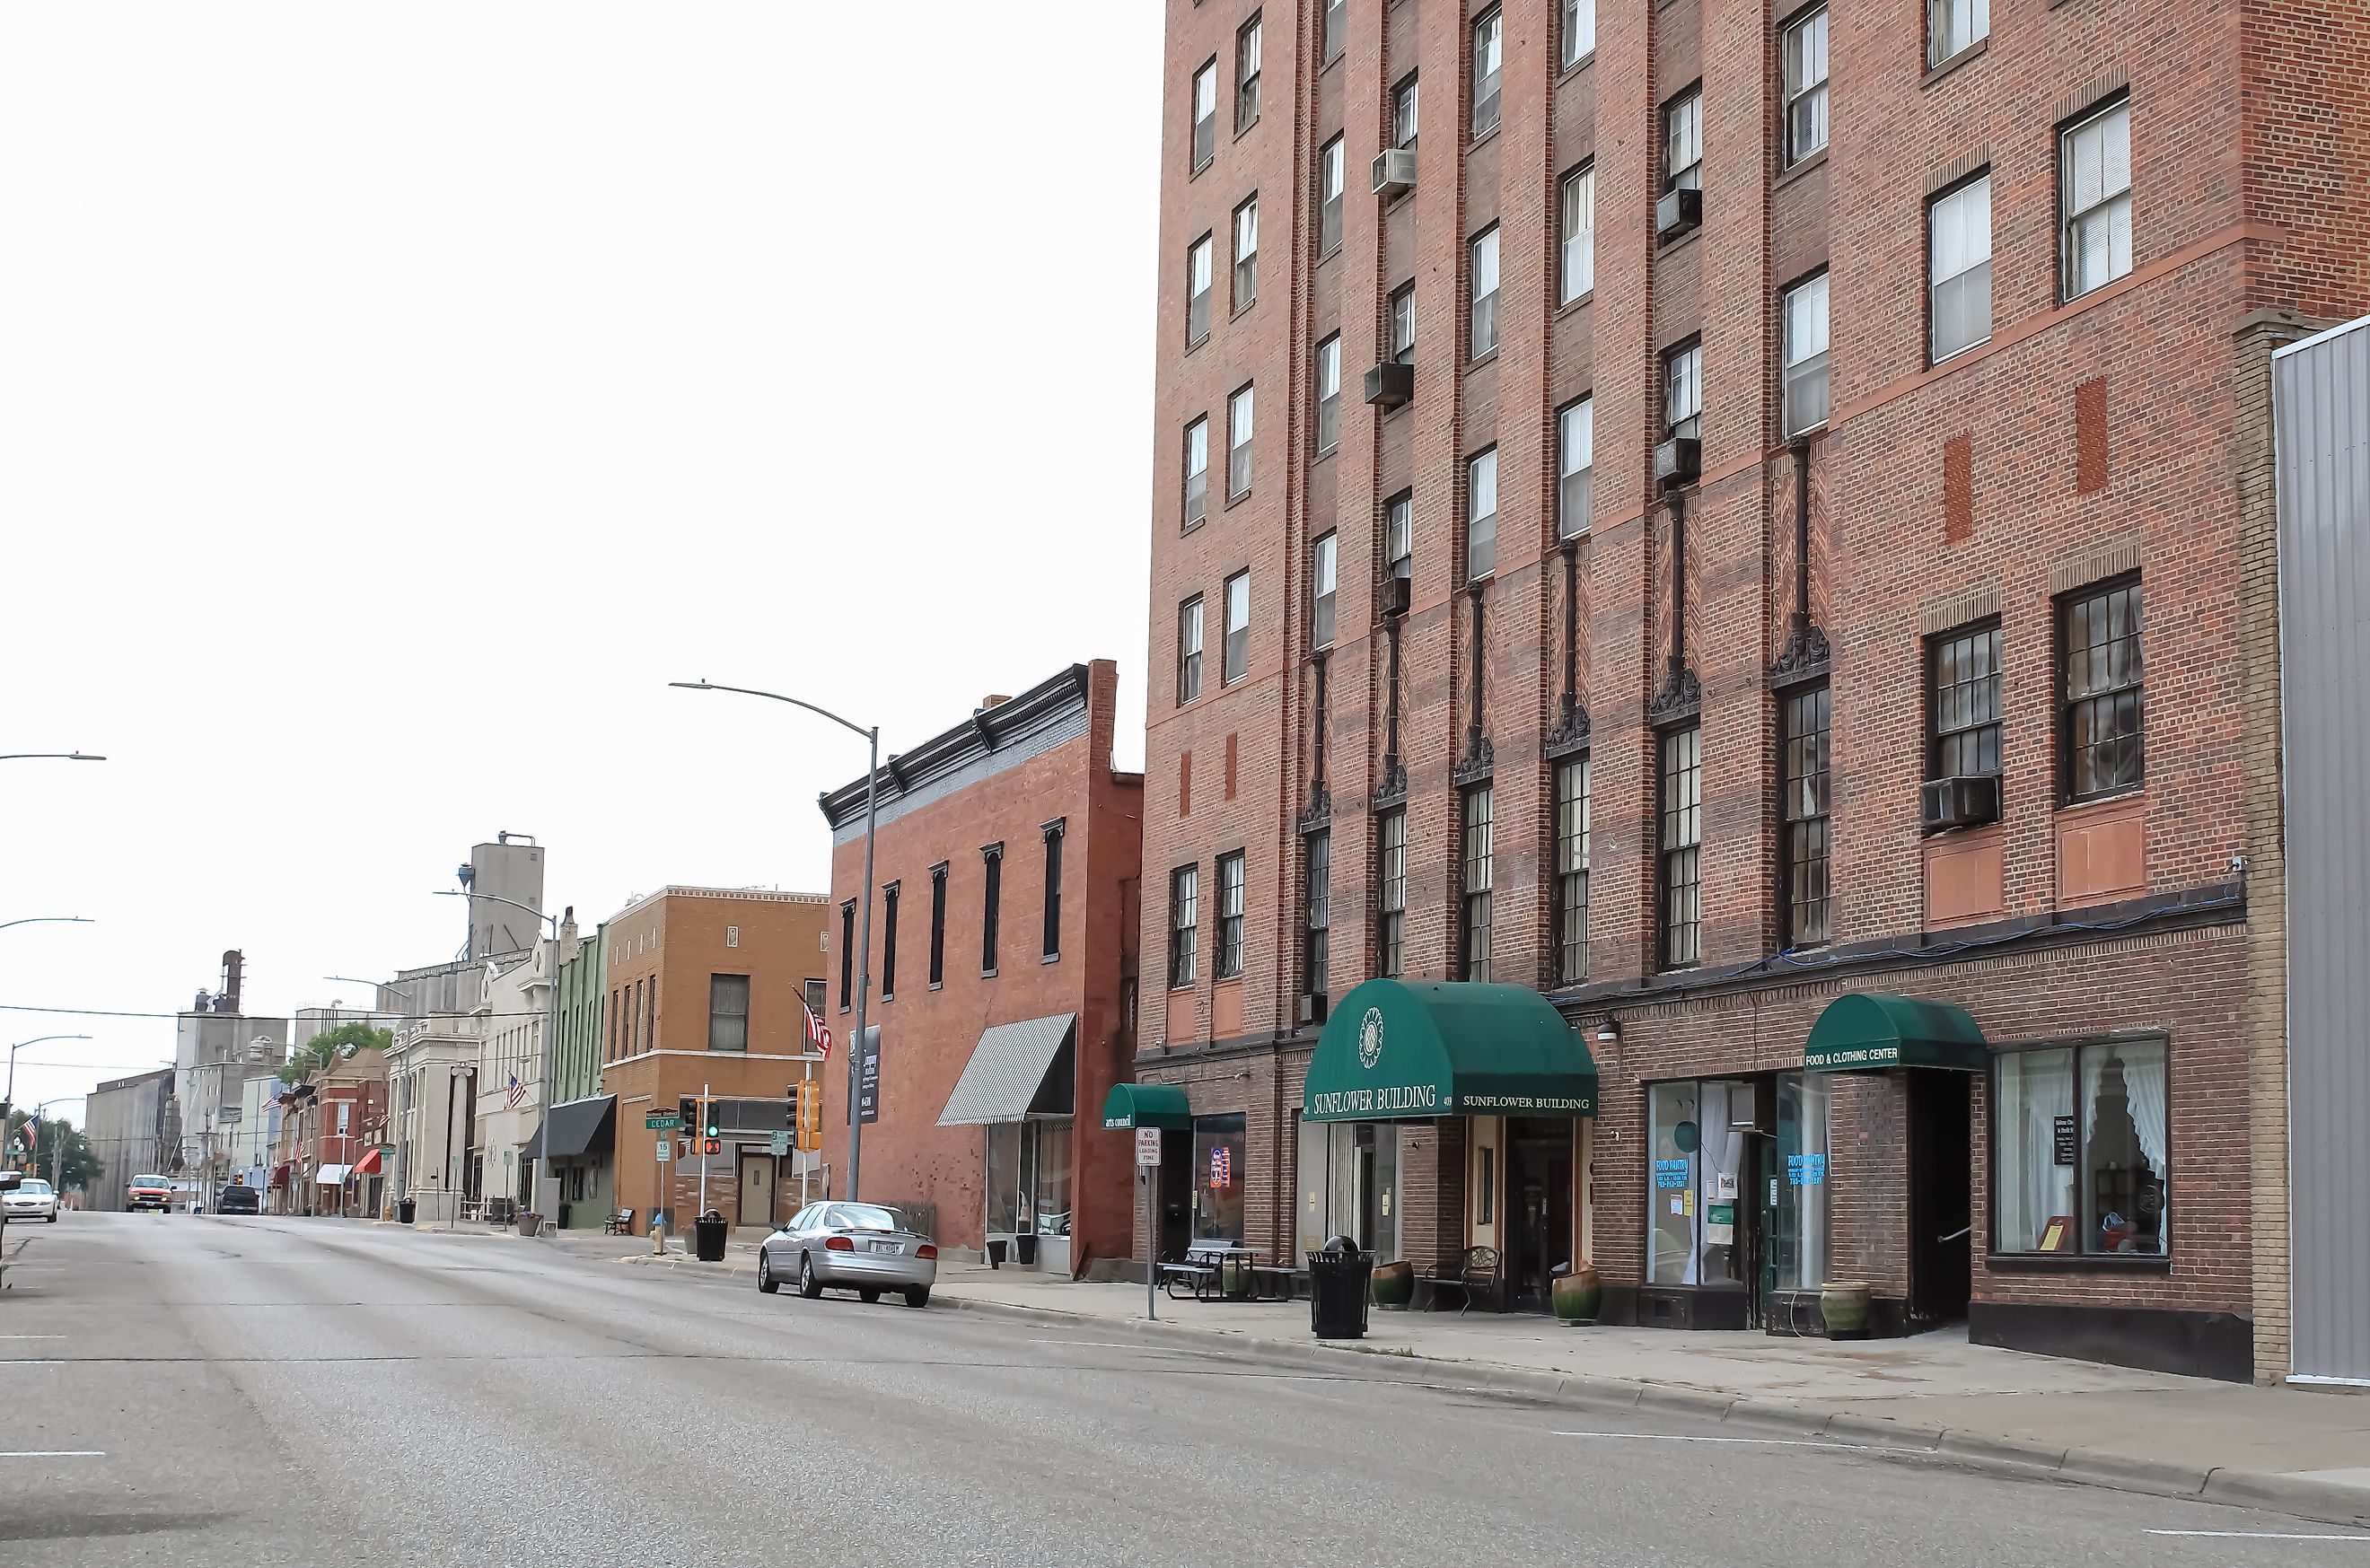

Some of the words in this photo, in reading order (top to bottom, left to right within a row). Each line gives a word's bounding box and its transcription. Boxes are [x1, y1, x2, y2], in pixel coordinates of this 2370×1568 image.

[1805, 1055, 1824, 1066] FOOD
[1826, 1054, 1831, 1064] &
[1832, 1048, 1867, 1064] CLOTHING
[1869, 1047, 1898, 1060] CENTER
[1313, 1089, 1374, 1115] SUNFLOWER
[1377, 1084, 1436, 1110] BUILDING
[1463, 1095, 1533, 1108] SUNFLOWER
[1535, 1098, 1590, 1109] BUILDING
[651, 1119, 674, 1128] CEDAR
[1105, 1117, 1114, 1127] arts
[1115, 1114, 1131, 1126] council
[1144, 1131, 1154, 1139] NO
[1138, 1139, 1158, 1147] PARKING
[1655, 1160, 1669, 1170] FOOD
[1669, 1159, 1689, 1172] PANTRY
[1787, 1154, 1803, 1167] FOOD
